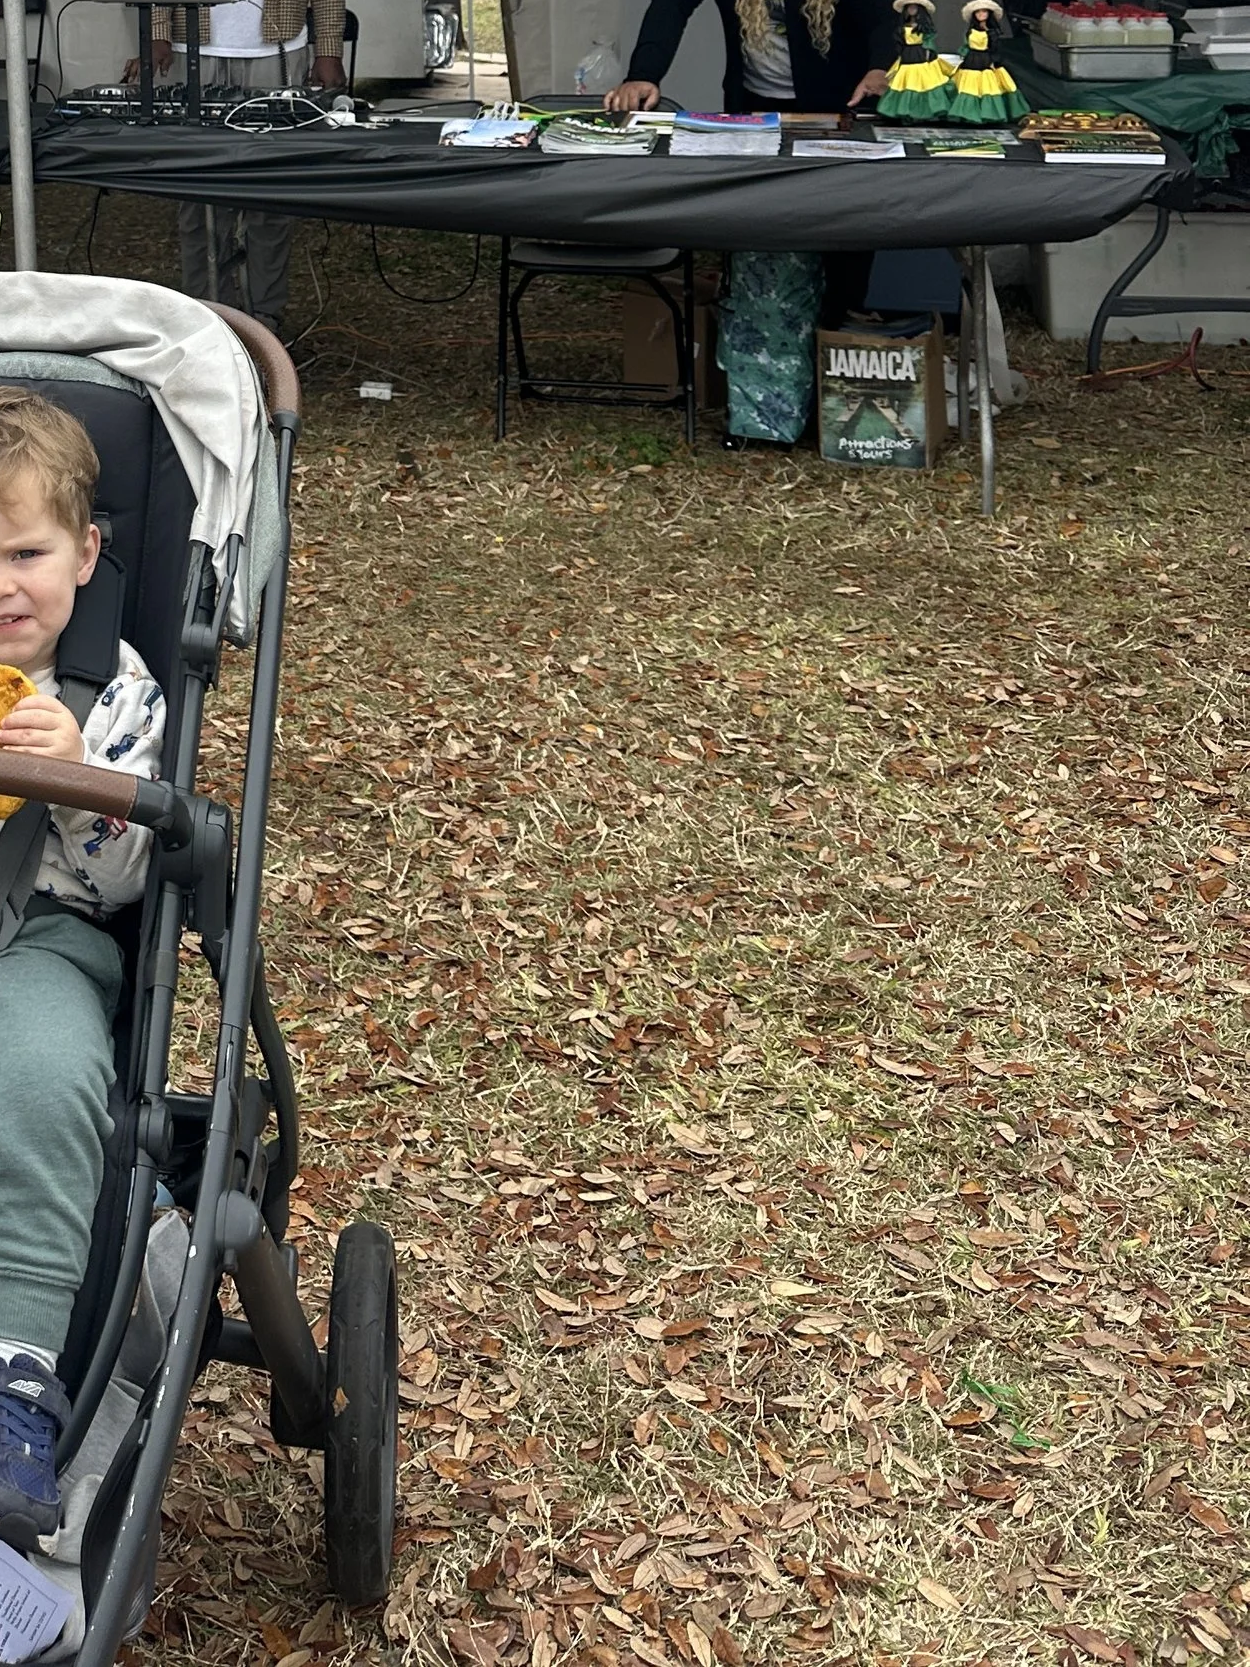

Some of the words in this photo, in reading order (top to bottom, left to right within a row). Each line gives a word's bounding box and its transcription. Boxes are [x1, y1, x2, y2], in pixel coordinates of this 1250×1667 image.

[825, 348, 917, 381] JAMAICA
[838, 436, 914, 450] Attractions
[856, 449, 893, 459] Tours
